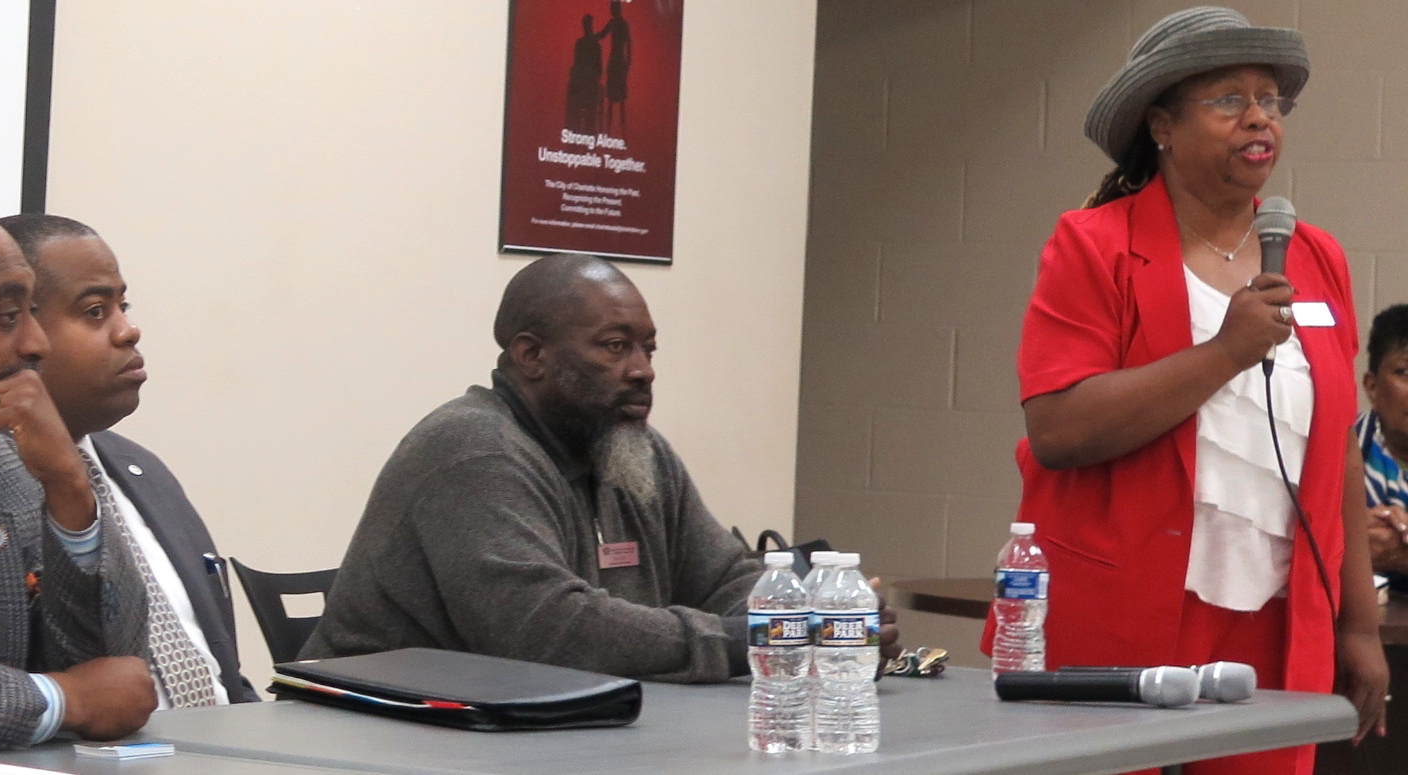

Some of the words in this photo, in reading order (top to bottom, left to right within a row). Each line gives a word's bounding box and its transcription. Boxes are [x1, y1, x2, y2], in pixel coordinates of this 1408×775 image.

[561, 128, 595, 150] Strong
[596, 133, 627, 150] Alone.
[538, 146, 601, 168] Unstoppable
[603, 154, 646, 173] Together.
[545, 179, 555, 189] The
[556, 180, 567, 191] City
[567, 182, 573, 190] of
[619, 188, 627, 196] the
[593, 196, 602, 204] the
[834, 621, 865, 630] DEER
[833, 629, 865, 638] PARK
